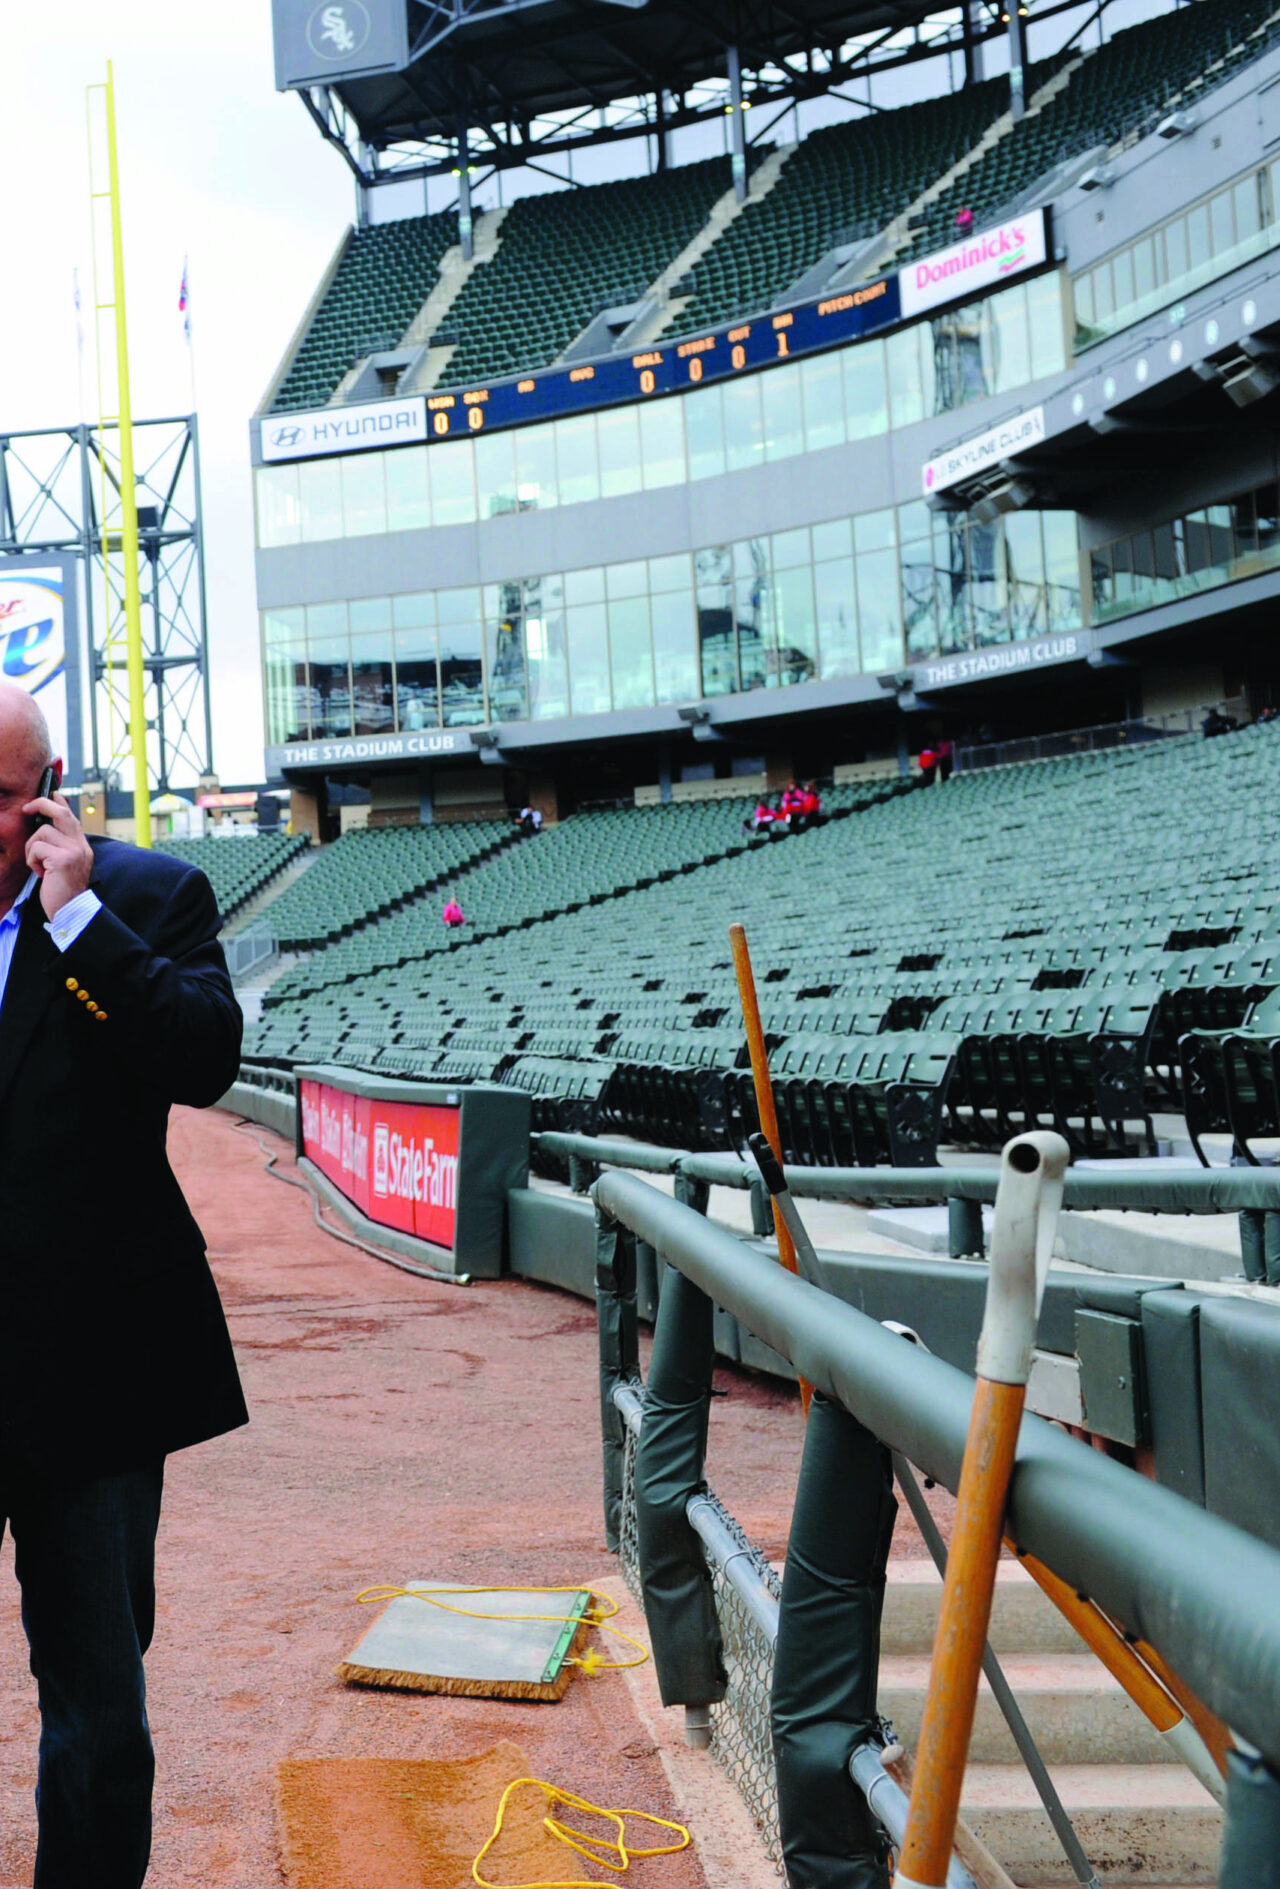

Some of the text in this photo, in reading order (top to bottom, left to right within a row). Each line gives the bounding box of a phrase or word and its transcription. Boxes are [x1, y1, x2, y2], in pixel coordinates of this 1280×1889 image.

[916, 227, 1025, 290] Dominick's
[732, 345, 745, 369] 0
[777, 332, 789, 357] 1
[640, 370, 655, 393] 0
[689, 358, 702, 381] 0
[313, 411, 417, 441] HYUNDAI
[434, 411, 449, 434] 0
[468, 407, 483, 430] 0
[948, 440, 996, 474] SKYLINE
[1000, 422, 1033, 448] CLUB
[927, 637, 1077, 684] THE STADIUM CLUB
[284, 735, 455, 763] THE STADIUM CLUB
